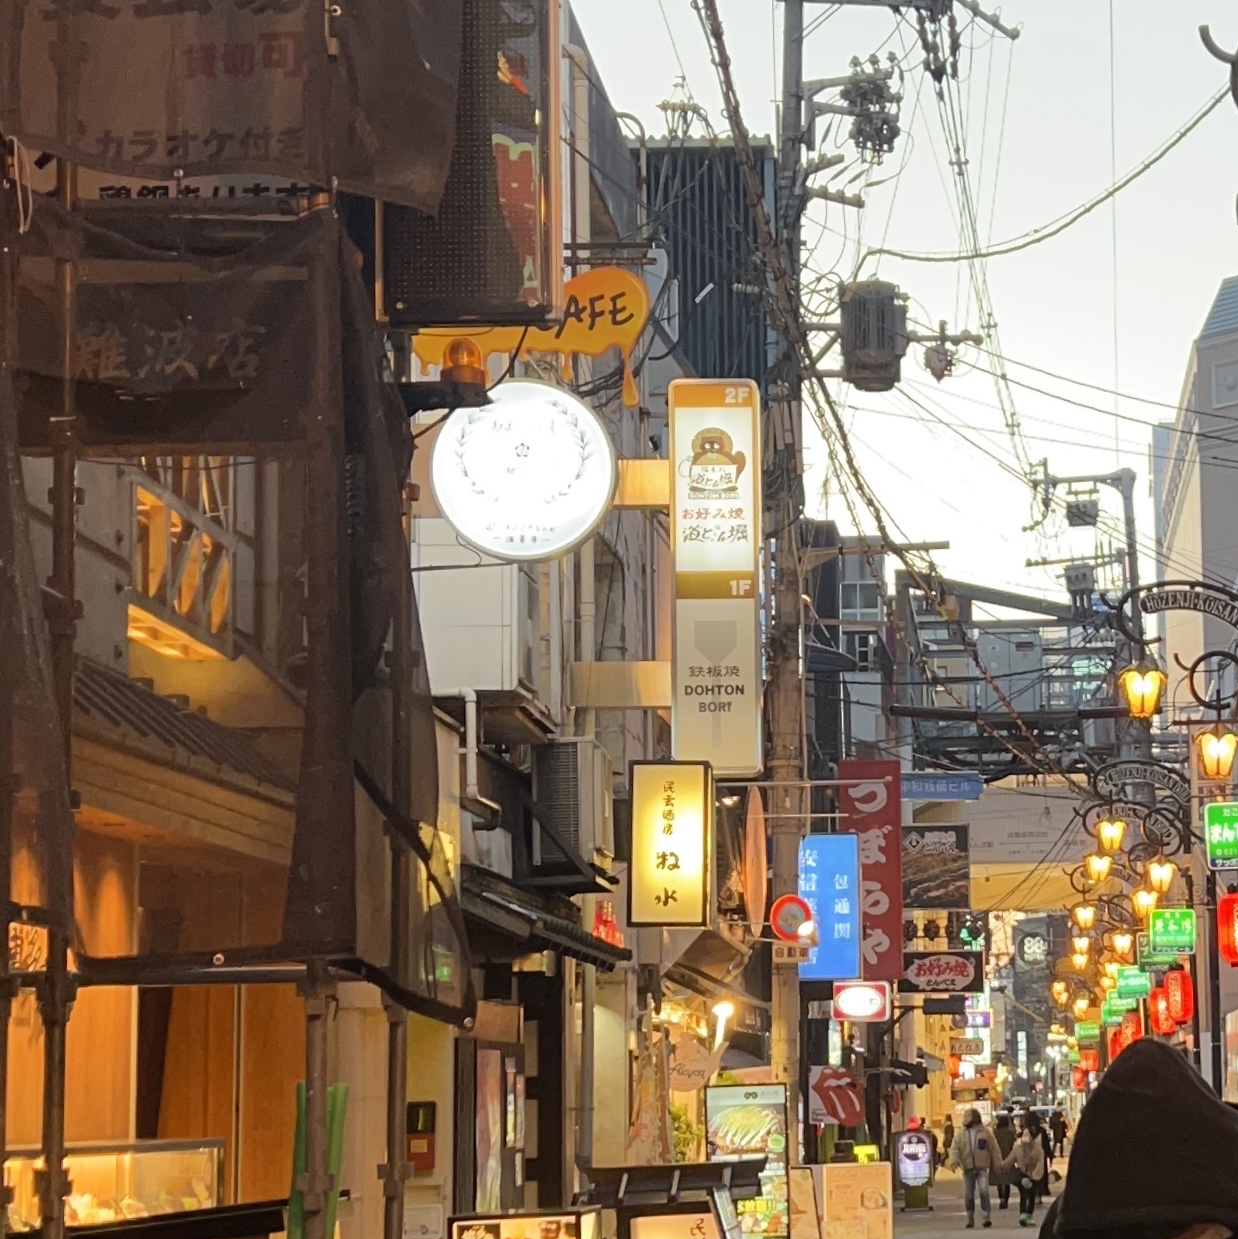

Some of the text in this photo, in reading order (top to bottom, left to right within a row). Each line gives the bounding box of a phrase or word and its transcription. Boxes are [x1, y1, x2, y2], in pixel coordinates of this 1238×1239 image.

[537, 291, 634, 338] AFE
[725, 387, 750, 404] 2F
[682, 507, 745, 520] お好み焼
[729, 579, 751, 596] 1F
[688, 665, 740, 678] 鉄板焼
[684, 685, 745, 696] DOHTON
[915, 957, 969, 977] お好み焼
